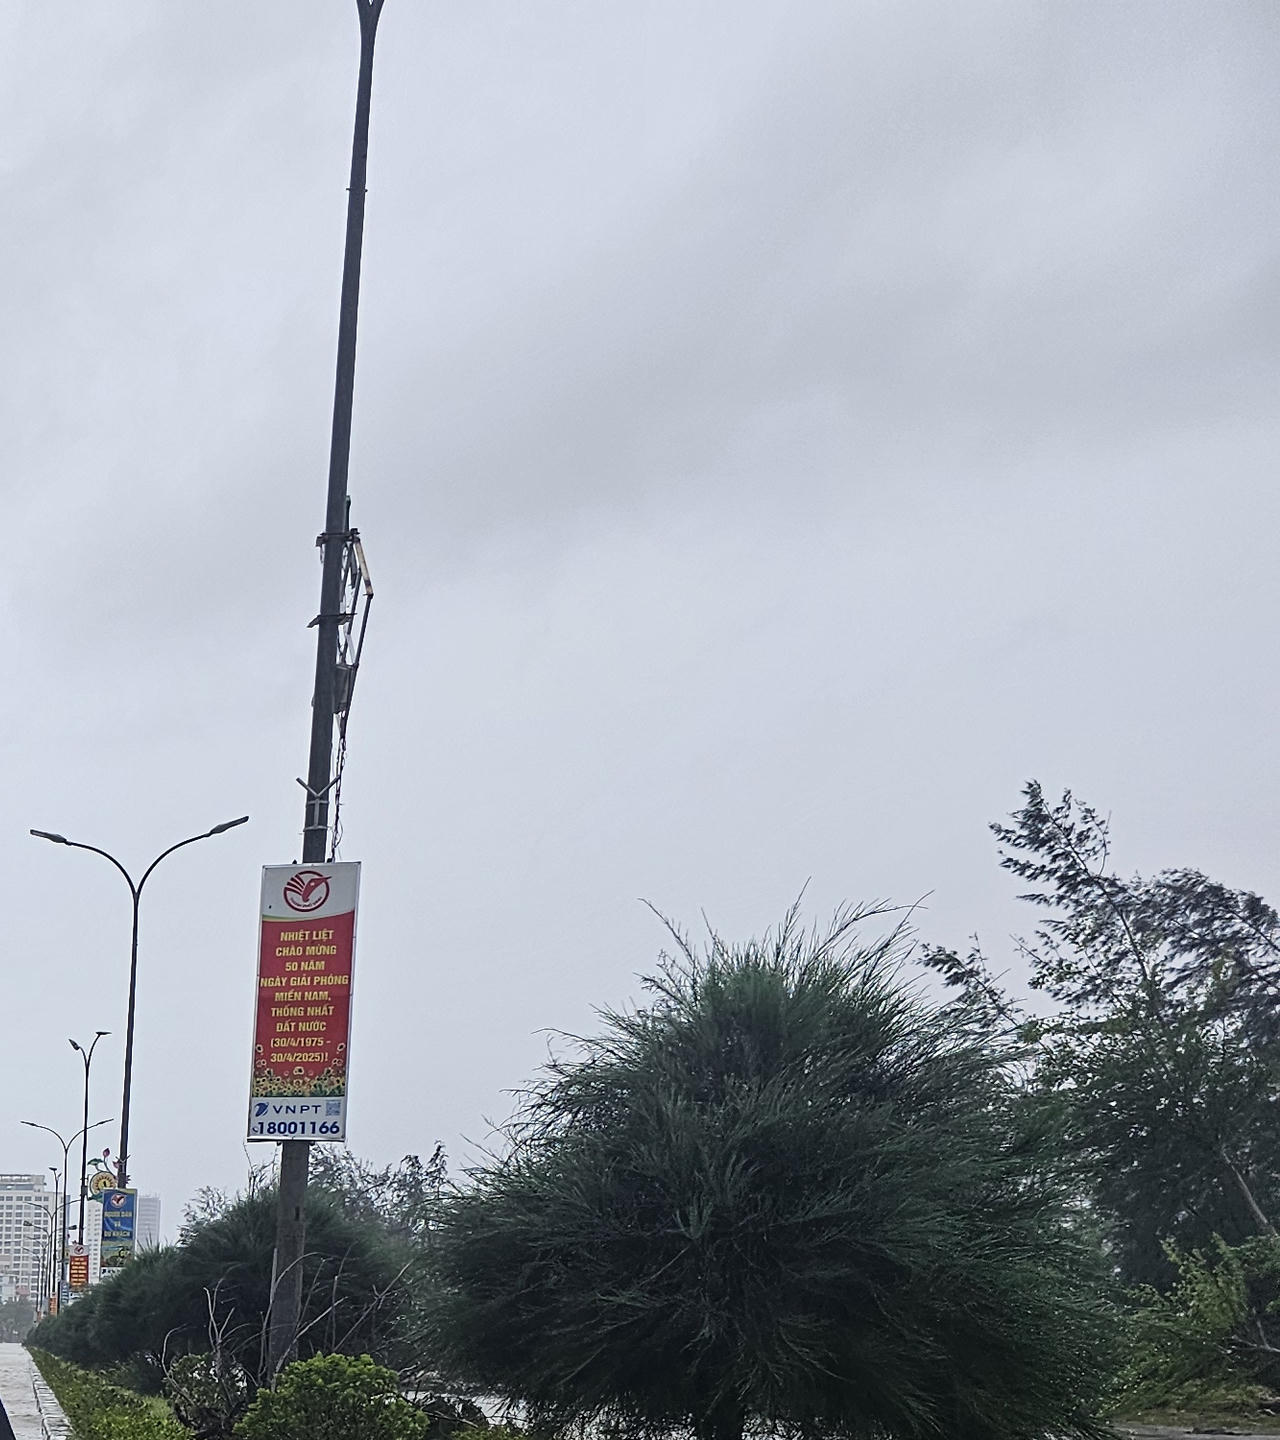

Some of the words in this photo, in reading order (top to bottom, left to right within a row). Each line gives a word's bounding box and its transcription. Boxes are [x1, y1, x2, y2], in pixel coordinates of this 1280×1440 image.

[280, 929, 310, 942] NHIỆT
[312, 929, 334, 942] LIỆT
[276, 944, 303, 957] CHÀO
[285, 961, 298, 971] 50
[301, 959, 325, 971] NĂM
[260, 976, 288, 987] NGÀY
[290, 974, 311, 986] GIẢI
[313, 973, 349, 986] PHÓNG
[271, 1003, 304, 1017] THỐNG
[307, 1002, 334, 1016] NHẤT
[276, 1018, 296, 1032] ĐẤT
[298, 1018, 327, 1031] NƯỚC
[270, 1037, 324, 1048] (30/4/1975
[270, 1052, 328, 1063] 30/4/2025)!
[272, 1105, 322, 1114] VNPT
[258, 1121, 340, 1135] 18001166
